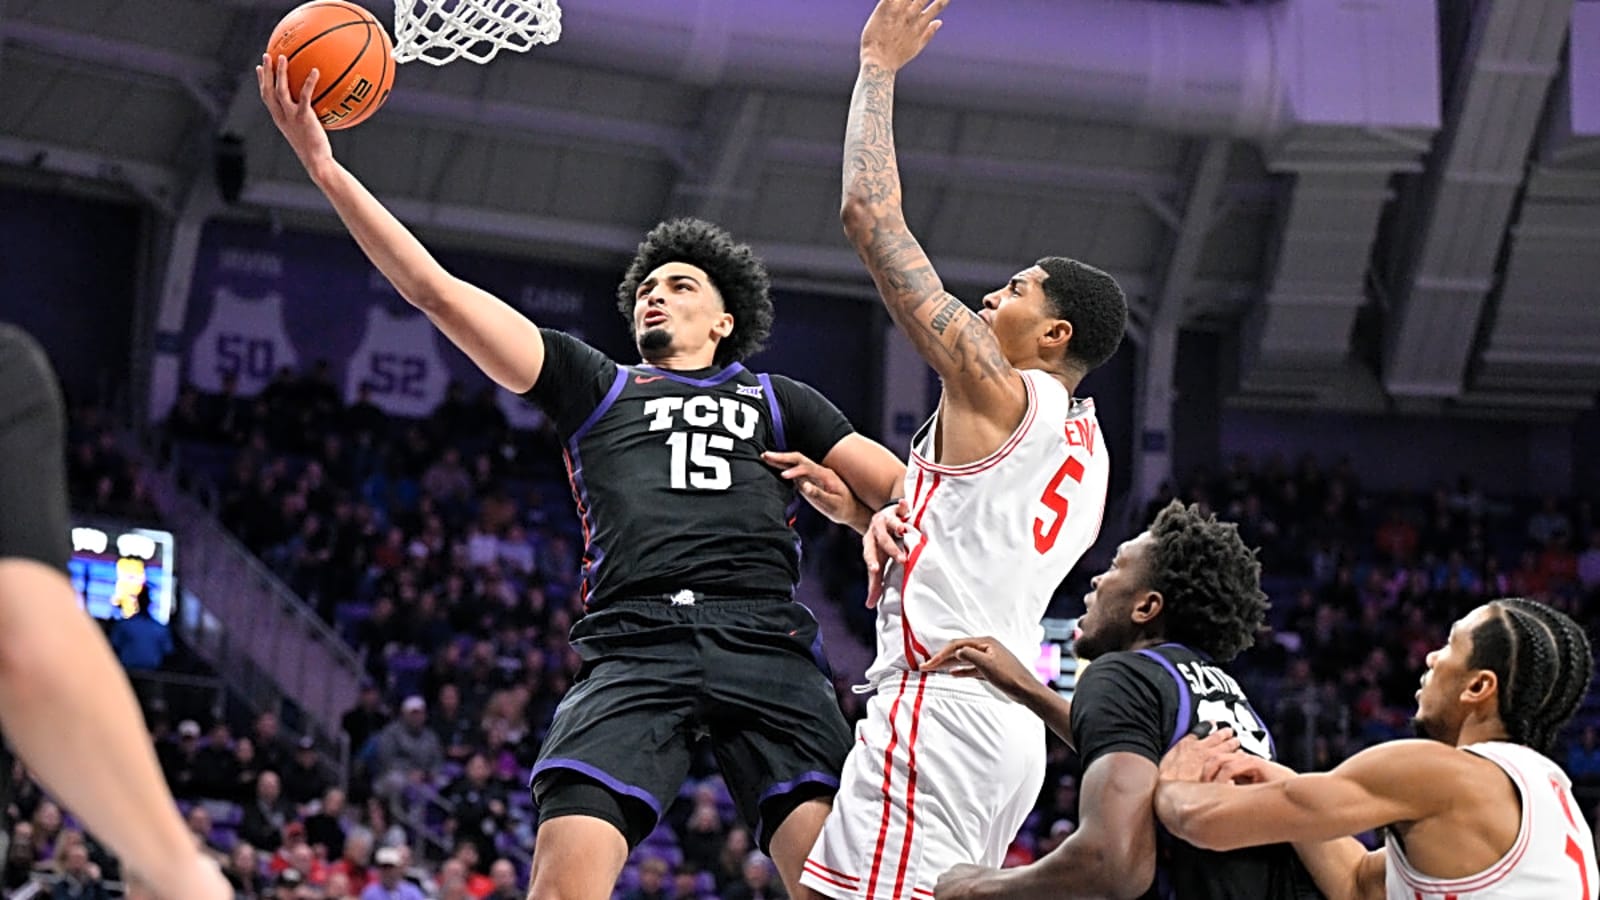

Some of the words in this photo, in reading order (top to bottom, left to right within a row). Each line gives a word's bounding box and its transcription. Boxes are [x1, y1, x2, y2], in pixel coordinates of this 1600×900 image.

[319, 78, 373, 125] ELITE
[216, 333, 274, 378] 50
[367, 353, 427, 397] 52
[643, 396, 759, 440] TCU
[665, 432, 734, 490] 15
[1033, 455, 1085, 555] 5
